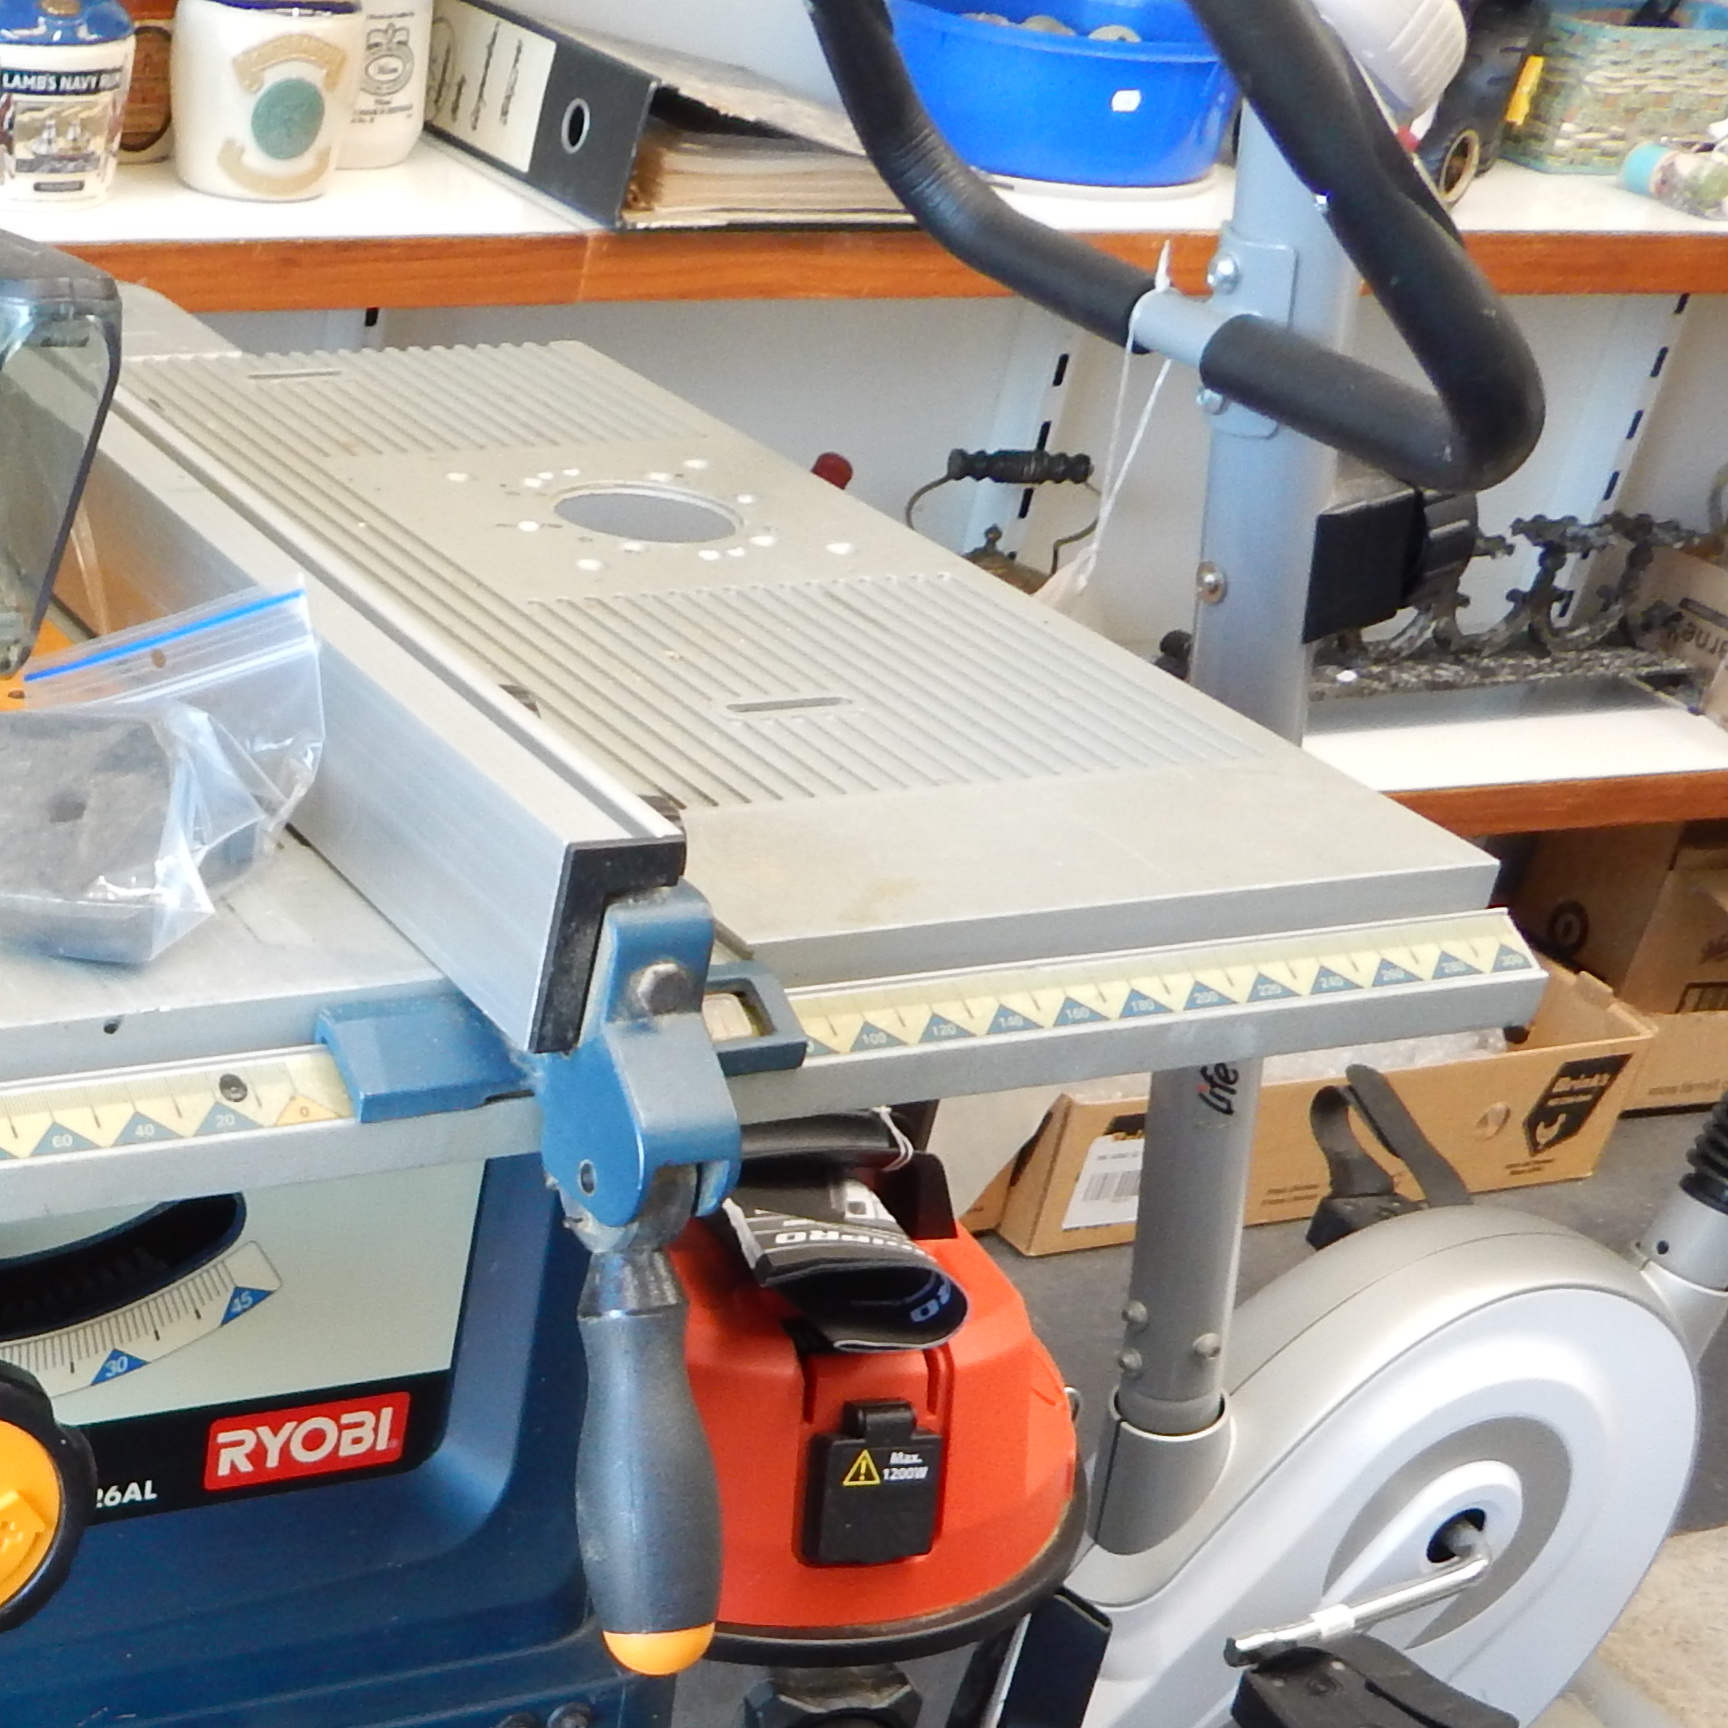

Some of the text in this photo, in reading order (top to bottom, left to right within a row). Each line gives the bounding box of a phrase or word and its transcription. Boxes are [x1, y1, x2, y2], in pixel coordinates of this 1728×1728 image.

[931, 1023, 956, 1037] 120
[999, 1014, 1023, 1028] 140
[52, 1134, 73, 1149] 60
[135, 1123, 155, 1138] 40
[215, 1113, 235, 1128] 20
[231, 1290, 253, 1314] 45
[106, 1355, 129, 1378] 30
[216, 1406, 394, 1477] RYOBI
[883, 1466, 929, 1481] 1200W
